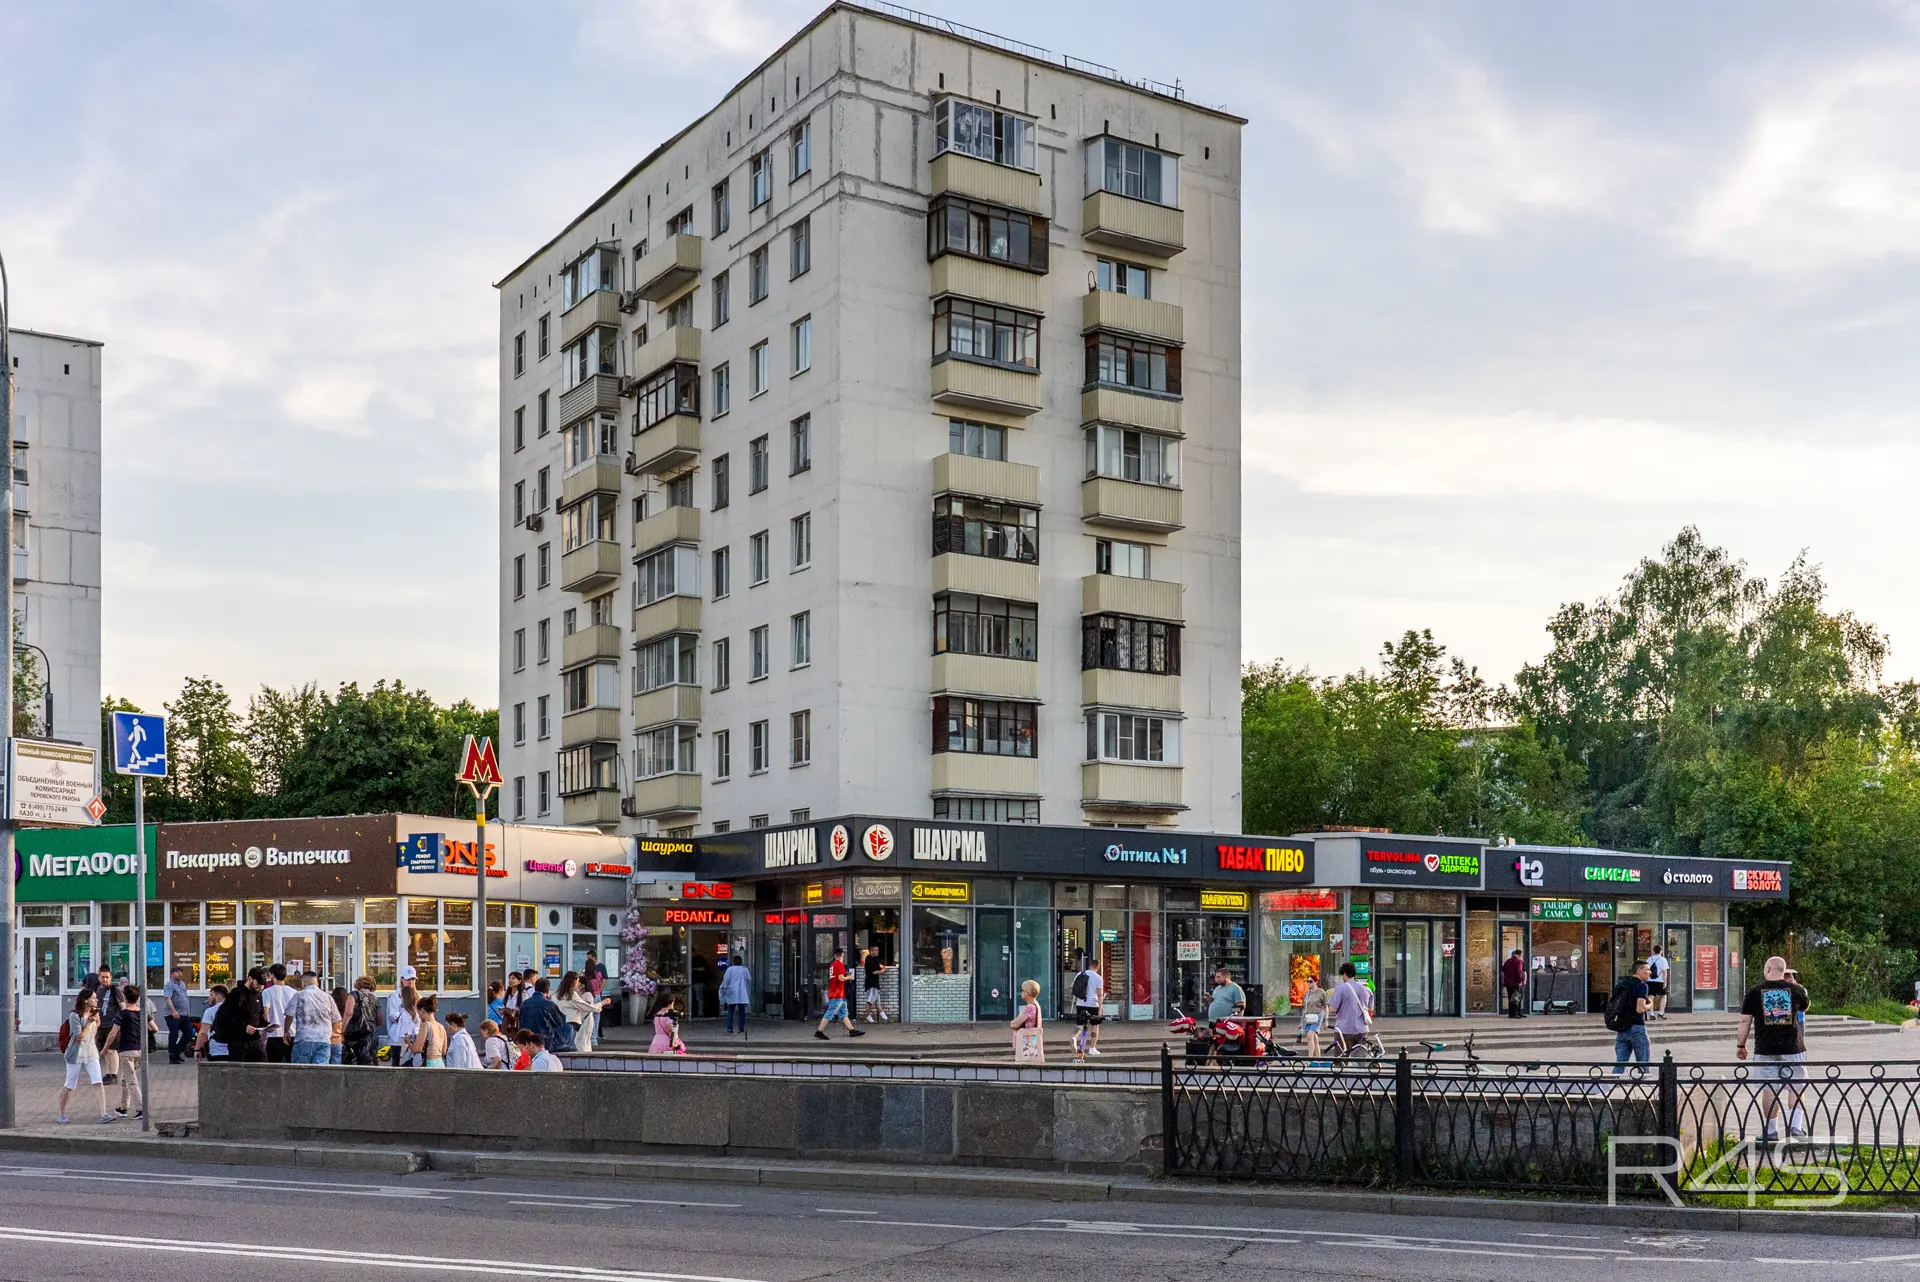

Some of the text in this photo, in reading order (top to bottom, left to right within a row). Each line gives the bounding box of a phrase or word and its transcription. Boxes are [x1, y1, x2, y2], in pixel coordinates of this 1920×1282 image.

[461, 734, 504, 784] М
[35, 785, 76, 795] КОМИССАРИАТ
[66, 779, 93, 789] ВОЕННЫЙ
[30, 792, 80, 802] ПЕРОВСКОГО РАЙОНА
[641, 841, 694, 856] шаурма
[765, 827, 817, 869] ШАУРМА
[913, 827, 987, 864] ШАУРМА
[165, 847, 351, 873] Пекарня Выпечка
[1163, 848, 1187, 865] №1
[1217, 845, 1305, 873] ТАБАК ПИВО
[1366, 850, 1421, 863] TERVOLINA
[1439, 855, 1479, 867] АПТЕКА
[529, 859, 576, 873] Цветы 24
[1369, 866, 1417, 876] обувь аксессуары
[1439, 864, 1470, 874] ЗДОРОВ
[1515, 855, 1544, 886] t2
[1584, 866, 1632, 882] САМСА
[1673, 873, 1713, 884] СТОЛОТО
[1747, 869, 1782, 881] СКУПКА
[682, 882, 733, 899] DNS
[1747, 880, 1782, 891] ЗОЛОТА
[924, 887, 965, 897] ВЫПЕЧКА
[1543, 901, 1573, 911] ТАНДЫР
[1588, 902, 1613, 910] САМСА
[665, 910, 730, 923] PEDANT.ru
[1544, 909, 1570, 918] САМСА
[1282, 924, 1321, 936] ОБУВЬ
[192, 963, 229, 972] БУОЧКИ
